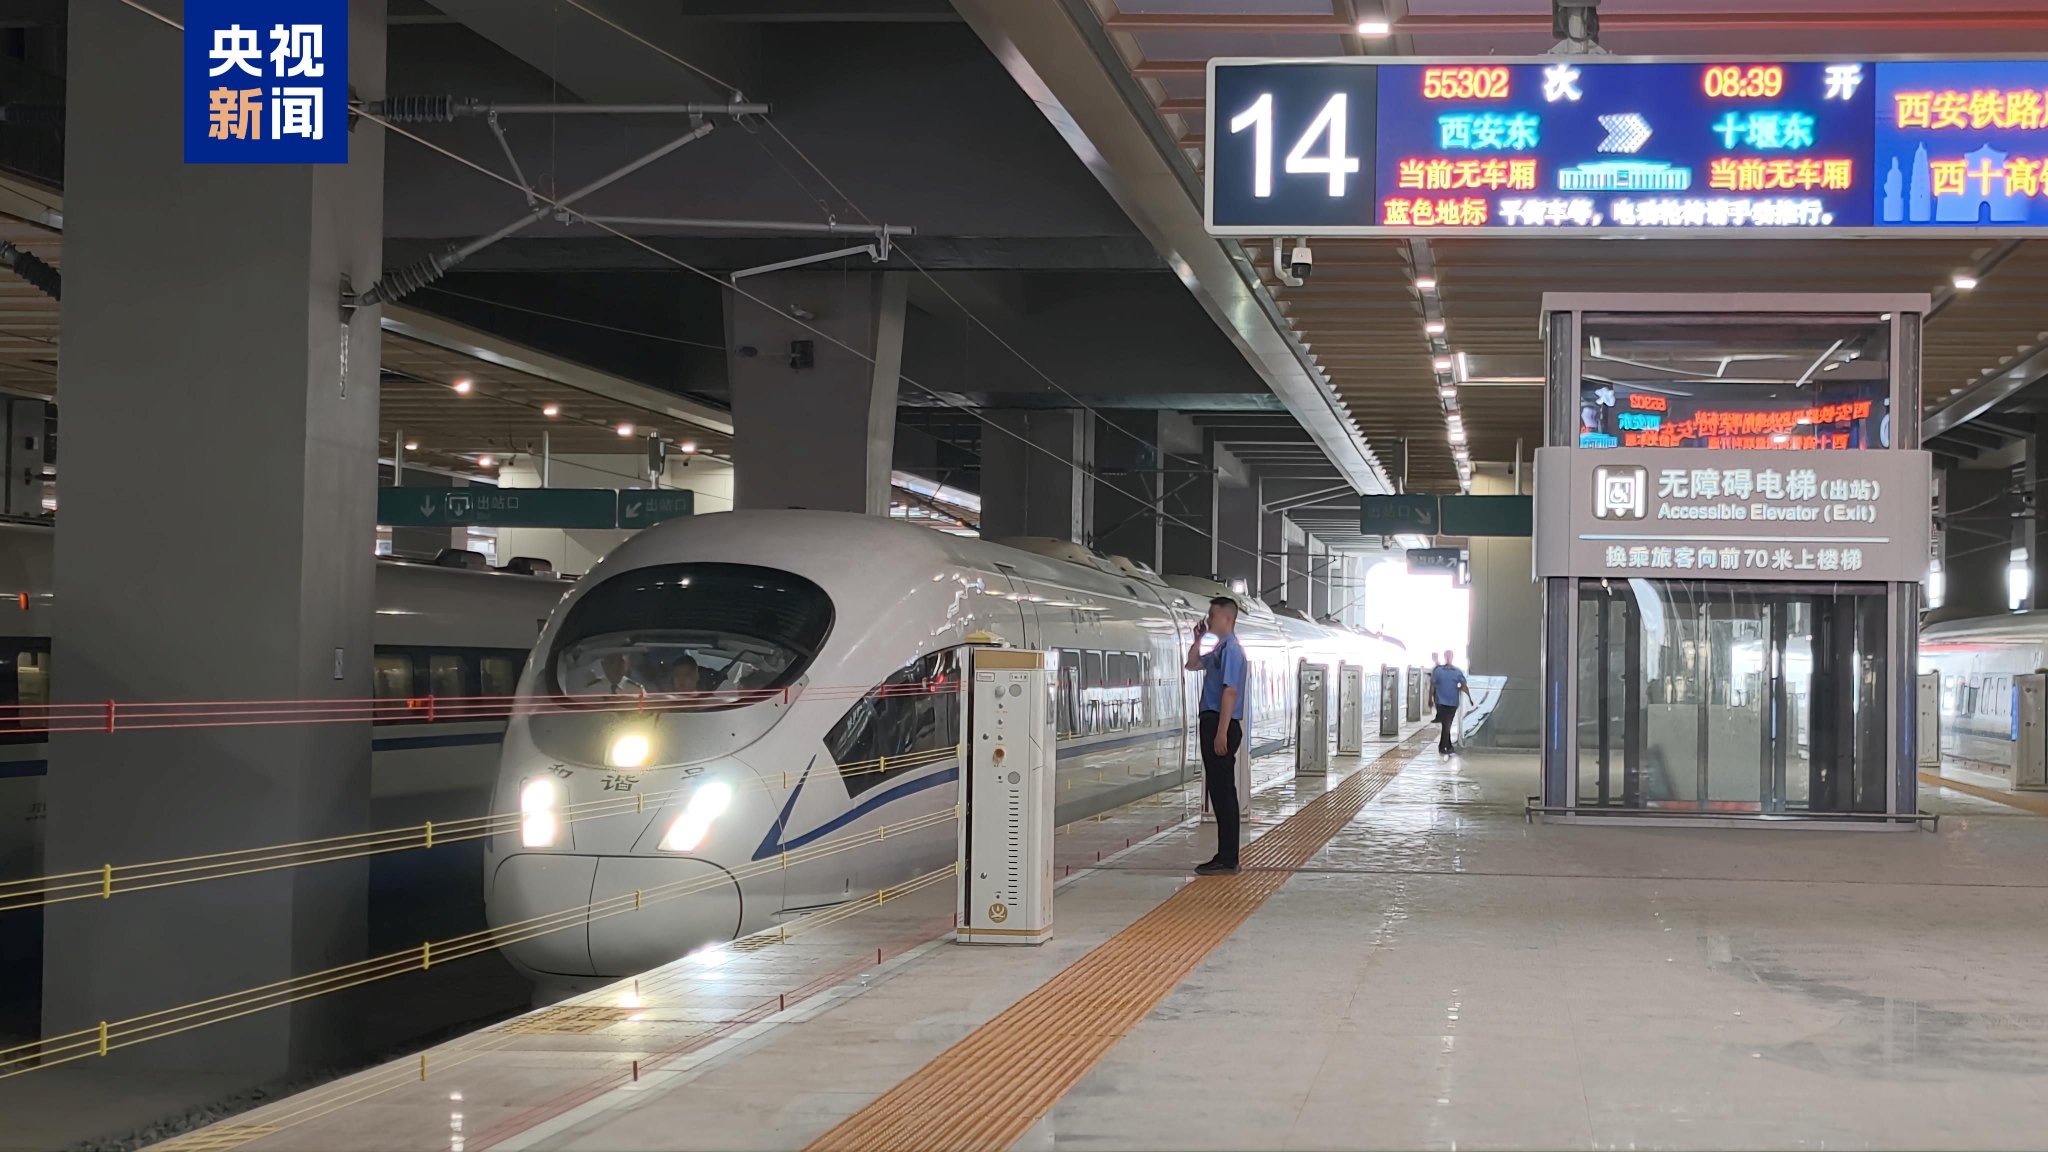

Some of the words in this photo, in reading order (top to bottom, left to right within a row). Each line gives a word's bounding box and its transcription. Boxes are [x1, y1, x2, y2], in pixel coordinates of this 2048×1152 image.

[1422, 68, 1510, 99] 55302
[1544, 64, 1582, 102] 次
[1703, 66, 1784, 98] 08:39
[1824, 64, 1864, 100] 开
[1895, 89, 2048, 130] 西安铁路
[1229, 92, 1360, 198] 14
[1438, 114, 1540, 150] 西安东
[1712, 111, 1816, 149] 十堰东
[1398, 159, 1536, 191] 当前无车厢
[1708, 159, 1853, 191] 当前无车厢
[1930, 157, 2048, 198] 西十高
[1383, 200, 1487, 226] 蓝色地标
[477, 495, 519, 510] 出站口
[1657, 502, 1746, 520] Accessible
[1750, 503, 1819, 521] Elevator
[1823, 503, 1877, 523] (Exit)
[1605, 545, 1863, 571] 换乘旅客向前70米上楼梯
